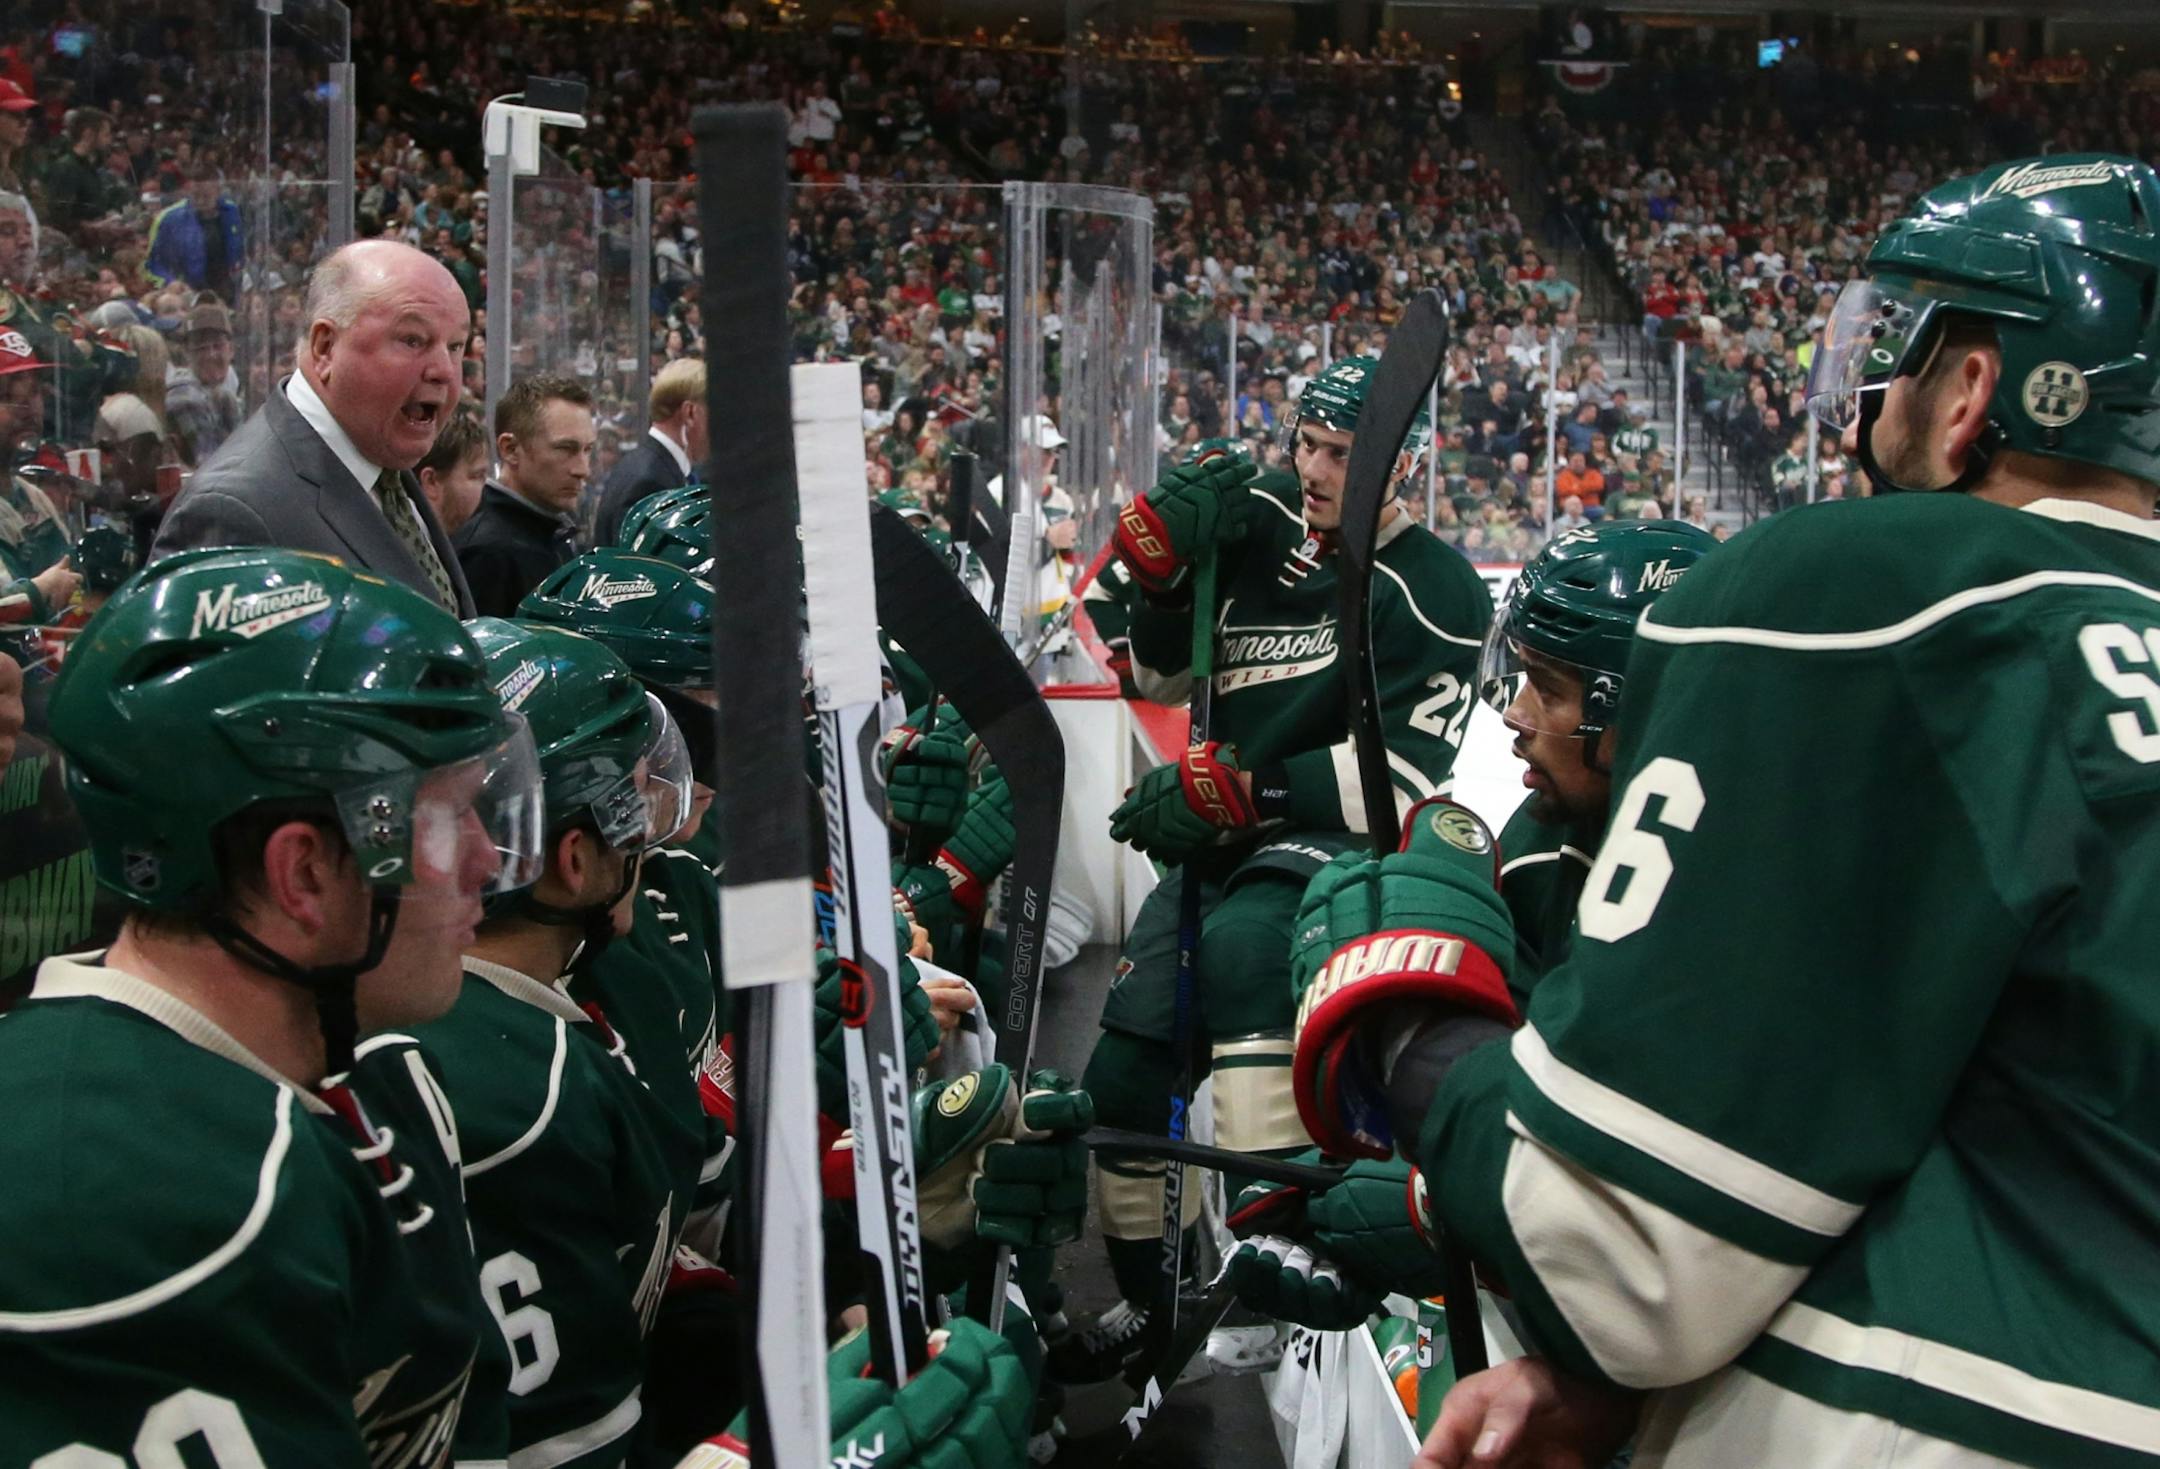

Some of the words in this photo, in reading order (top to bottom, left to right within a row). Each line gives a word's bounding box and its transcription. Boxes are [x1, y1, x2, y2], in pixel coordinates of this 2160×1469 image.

[1981, 159, 2112, 200] Minnesota
[1312, 389, 1348, 406] BAUER
[1331, 365, 1366, 384] 22
[188, 580, 326, 640] Minnesota
[577, 573, 656, 602] Minnesota
[497, 658, 541, 704] nesota
[1221, 664, 1299, 689] WILD
[1408, 671, 1472, 749] 22
[1578, 755, 1707, 944] 6
[0, 849, 98, 980] BWAY
[1007, 923, 1034, 1032] COVERT
[1023, 886, 1040, 921] QR
[878, 1052, 925, 1308] DYNASTY
